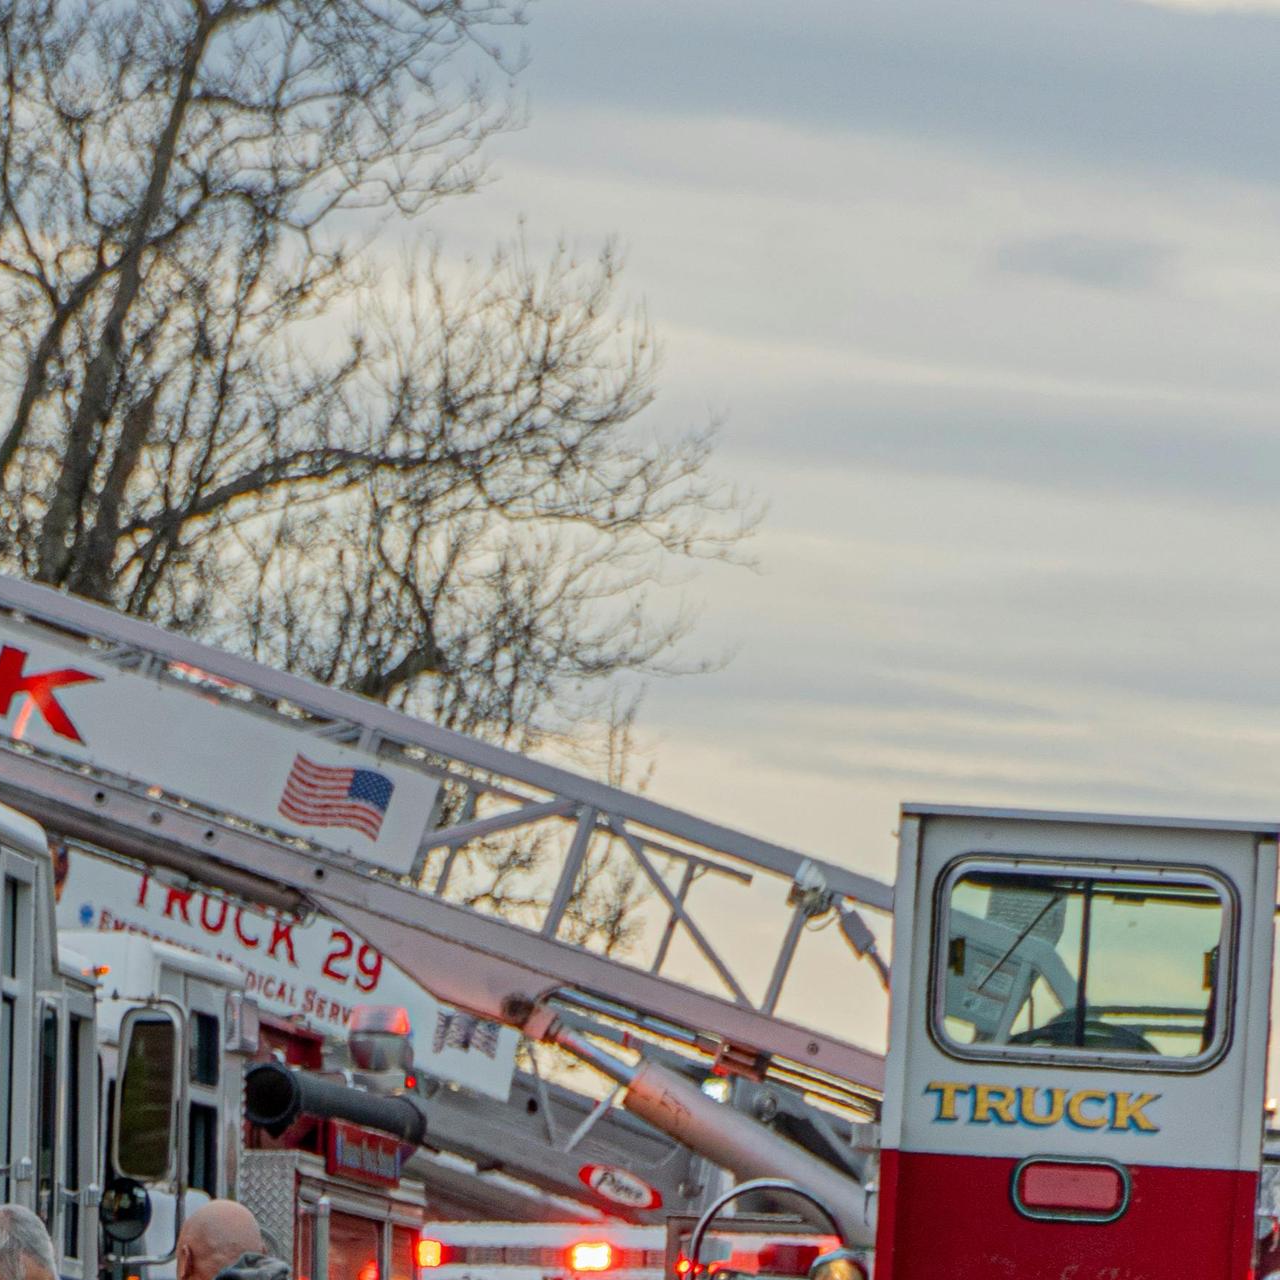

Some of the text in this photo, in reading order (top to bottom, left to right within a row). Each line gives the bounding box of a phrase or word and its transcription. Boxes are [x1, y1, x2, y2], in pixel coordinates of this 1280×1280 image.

[136, 873, 298, 970] TRUCK
[320, 927, 384, 993] 29
[924, 1080, 1162, 1134] TRUCK
